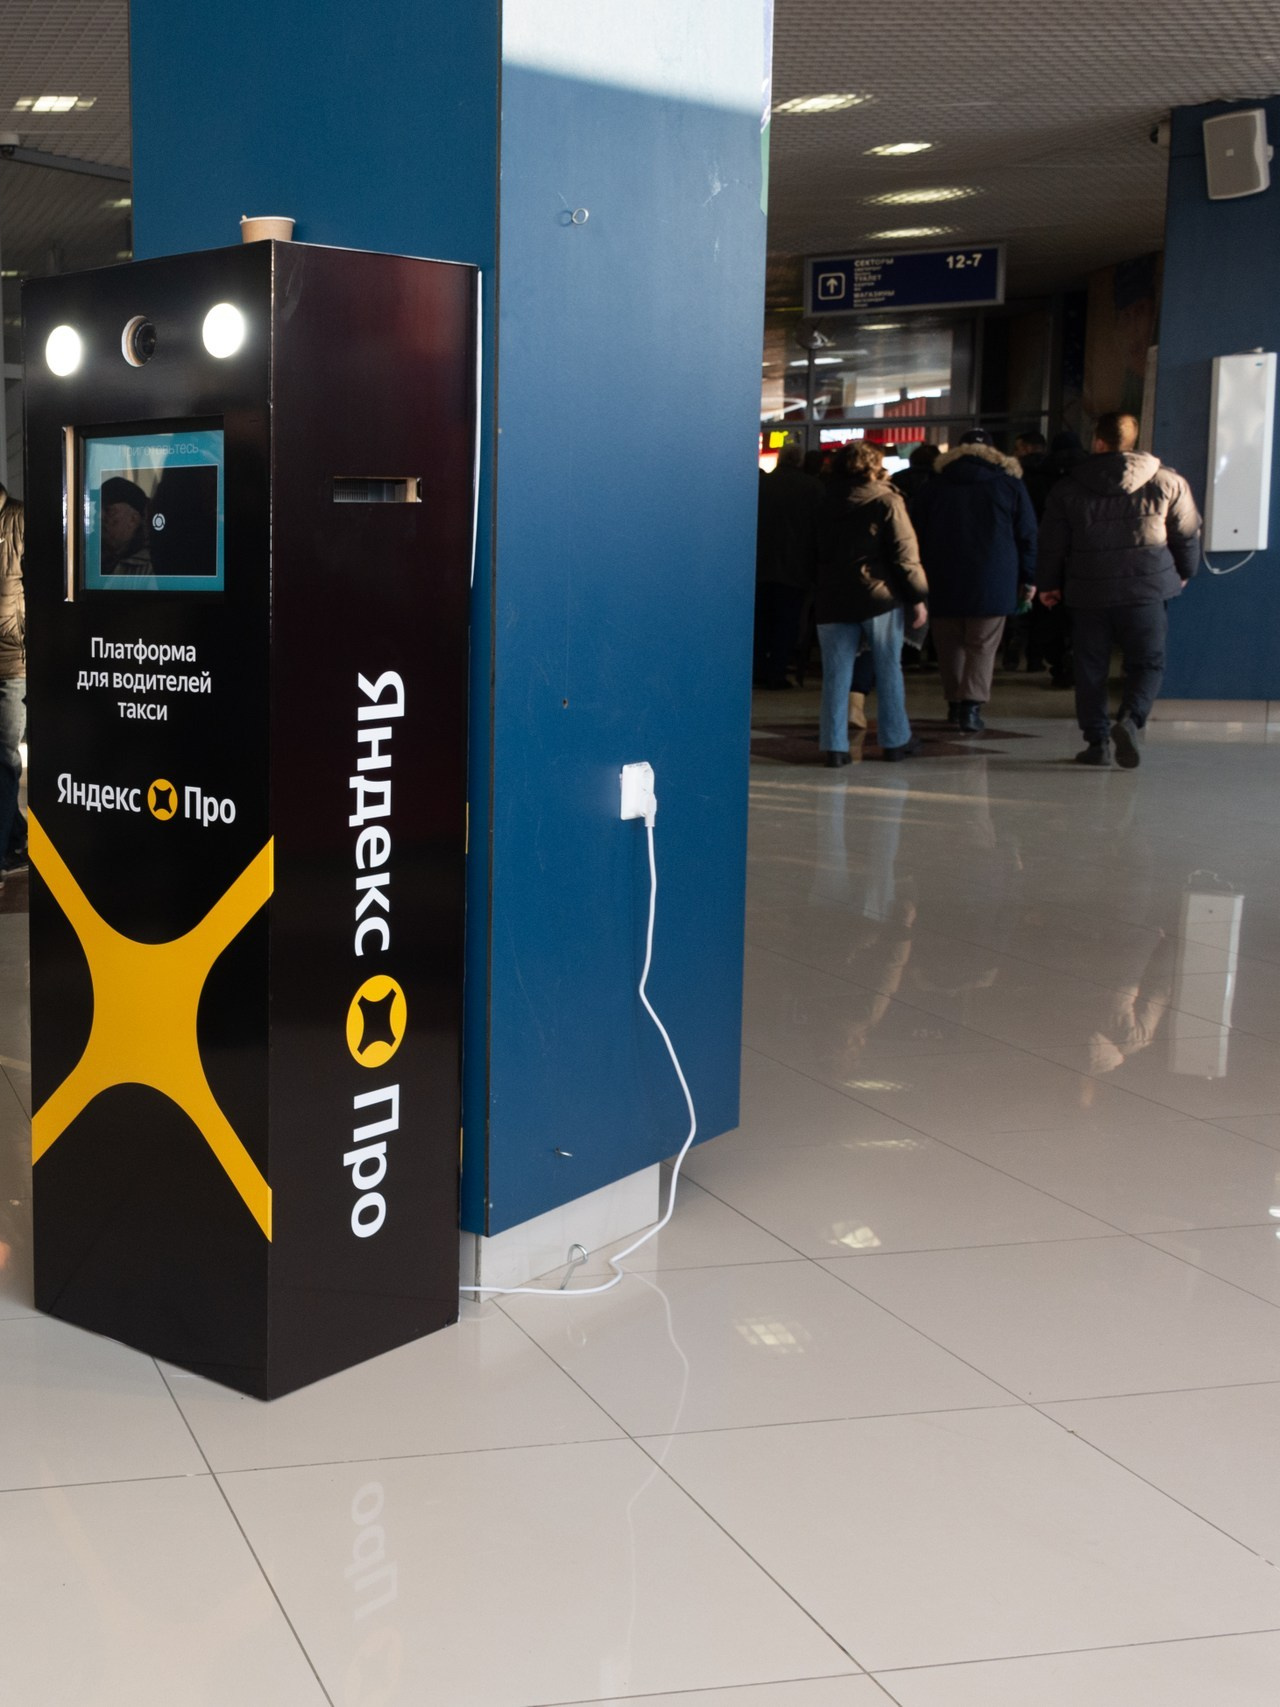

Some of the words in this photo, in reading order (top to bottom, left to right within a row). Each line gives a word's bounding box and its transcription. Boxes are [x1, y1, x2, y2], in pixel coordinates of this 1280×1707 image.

[854, 258, 894, 268] СЕКТОРЫ
[946, 254, 983, 269] 12-7
[854, 274, 882, 282] ТУАЛЕТ
[853, 290, 895, 298] МАГАЗИНЫ
[91, 637, 196, 665] Платформа
[77, 671, 109, 690] для
[113, 671, 212, 693] водителей
[118, 702, 168, 721] такси
[57, 773, 141, 812] Яндекс
[185, 786, 236, 827] Про
[349, 670, 405, 956] Яндекс
[343, 1083, 400, 1238] Про
